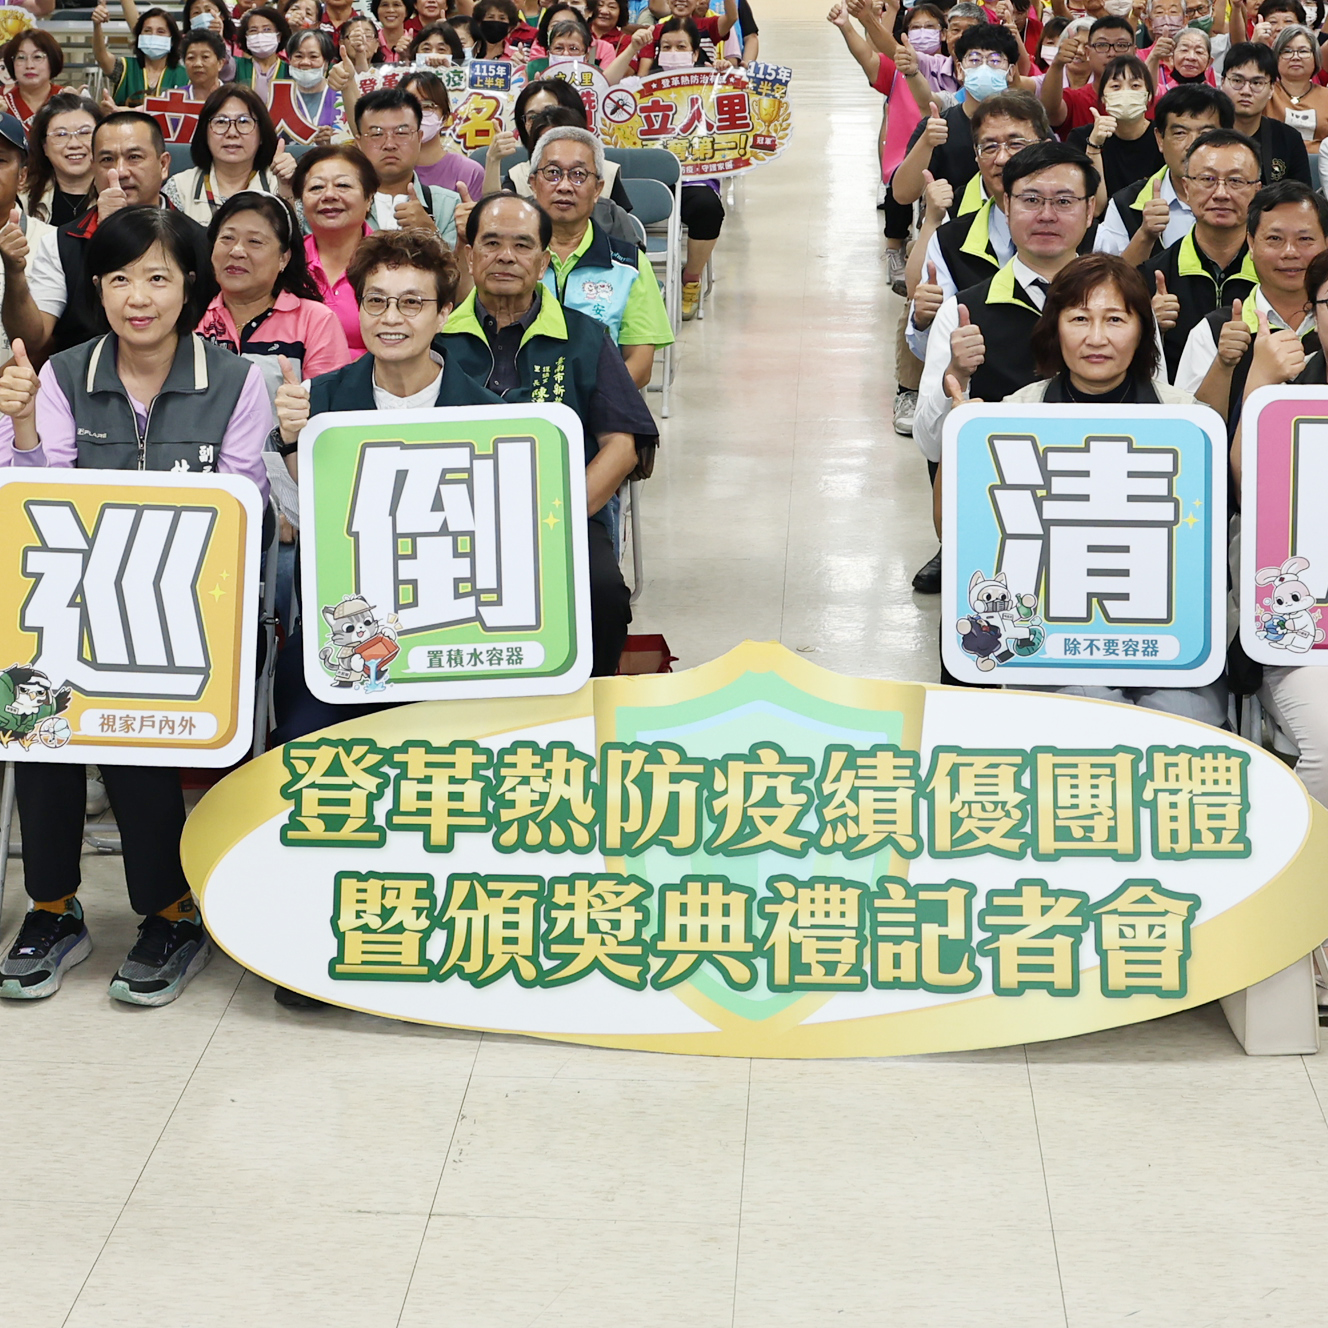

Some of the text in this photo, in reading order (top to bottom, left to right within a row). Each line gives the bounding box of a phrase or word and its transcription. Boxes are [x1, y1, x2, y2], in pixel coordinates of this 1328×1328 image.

[473, 63, 507, 77] 115年
[473, 76, 506, 89] 上半年
[748, 62, 793, 83] 115年
[637, 92, 753, 138] 立人里
[347, 437, 541, 633] 倒
[989, 435, 1179, 624] 清
[22, 500, 217, 700] 巡
[426, 646, 525, 669] 置積水容器
[1063, 637, 1160, 658] 除不要容器
[98, 713, 196, 737] 視家戶內外
[282, 738, 1250, 861] 登革熱防疫績優團體
[332, 872, 1198, 997] 暨頒獎典禮記者會
